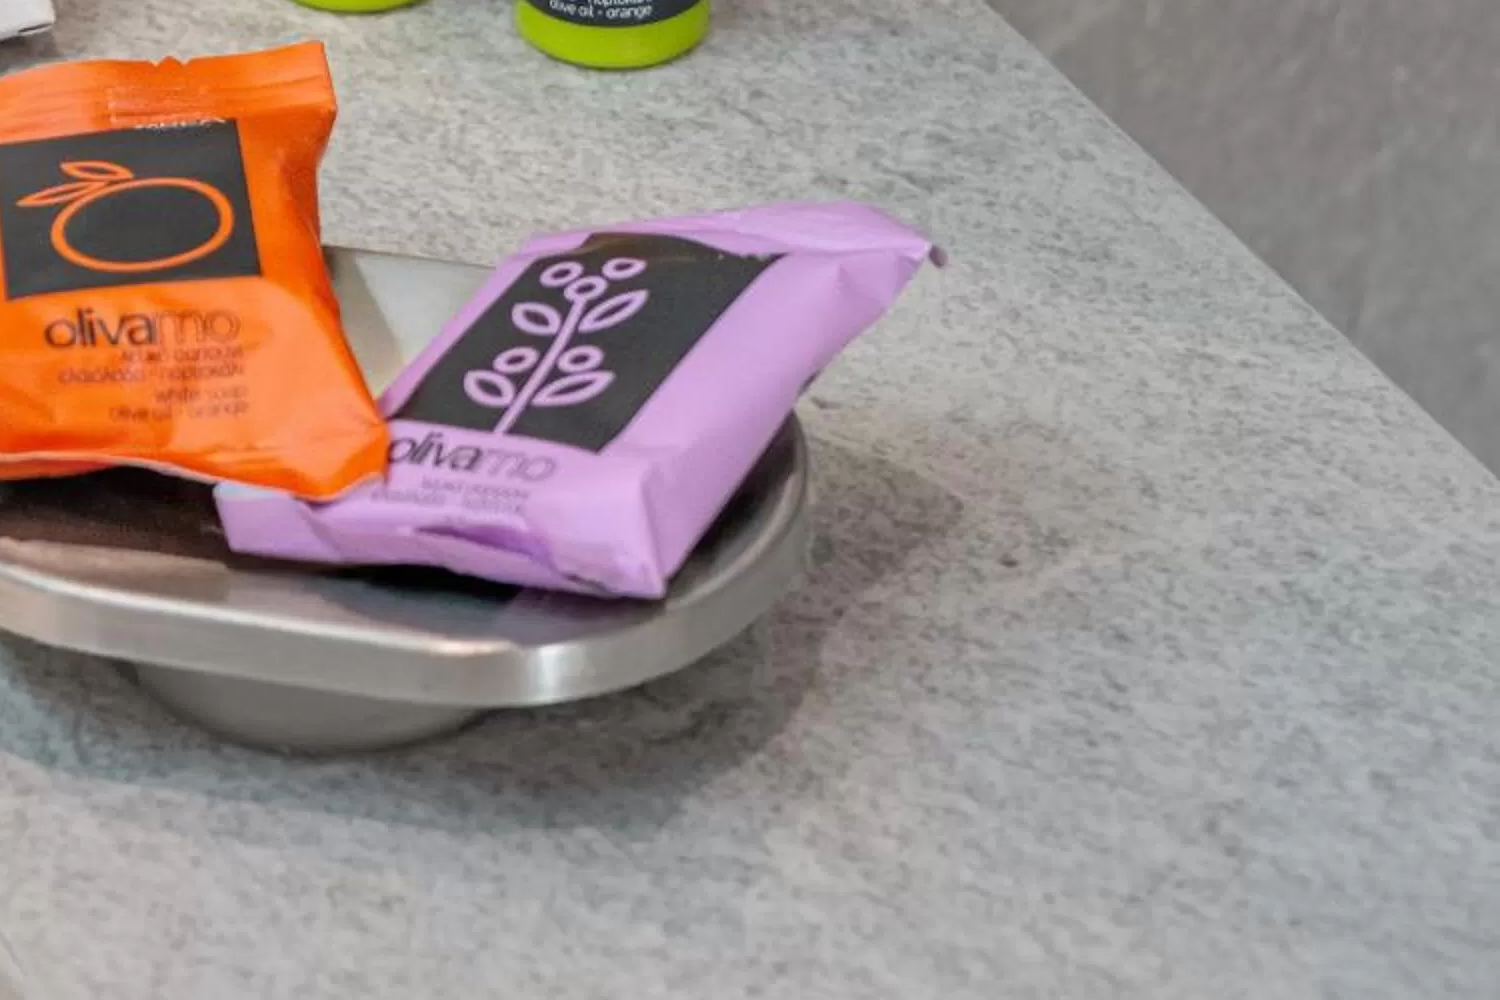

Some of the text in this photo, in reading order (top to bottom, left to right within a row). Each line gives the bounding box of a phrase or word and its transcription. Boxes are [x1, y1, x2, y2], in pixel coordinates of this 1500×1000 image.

[578, 3, 595, 19] oil
[605, 3, 653, 20] orange
[43, 306, 242, 349] olivamo
[388, 431, 556, 481] olivamo
